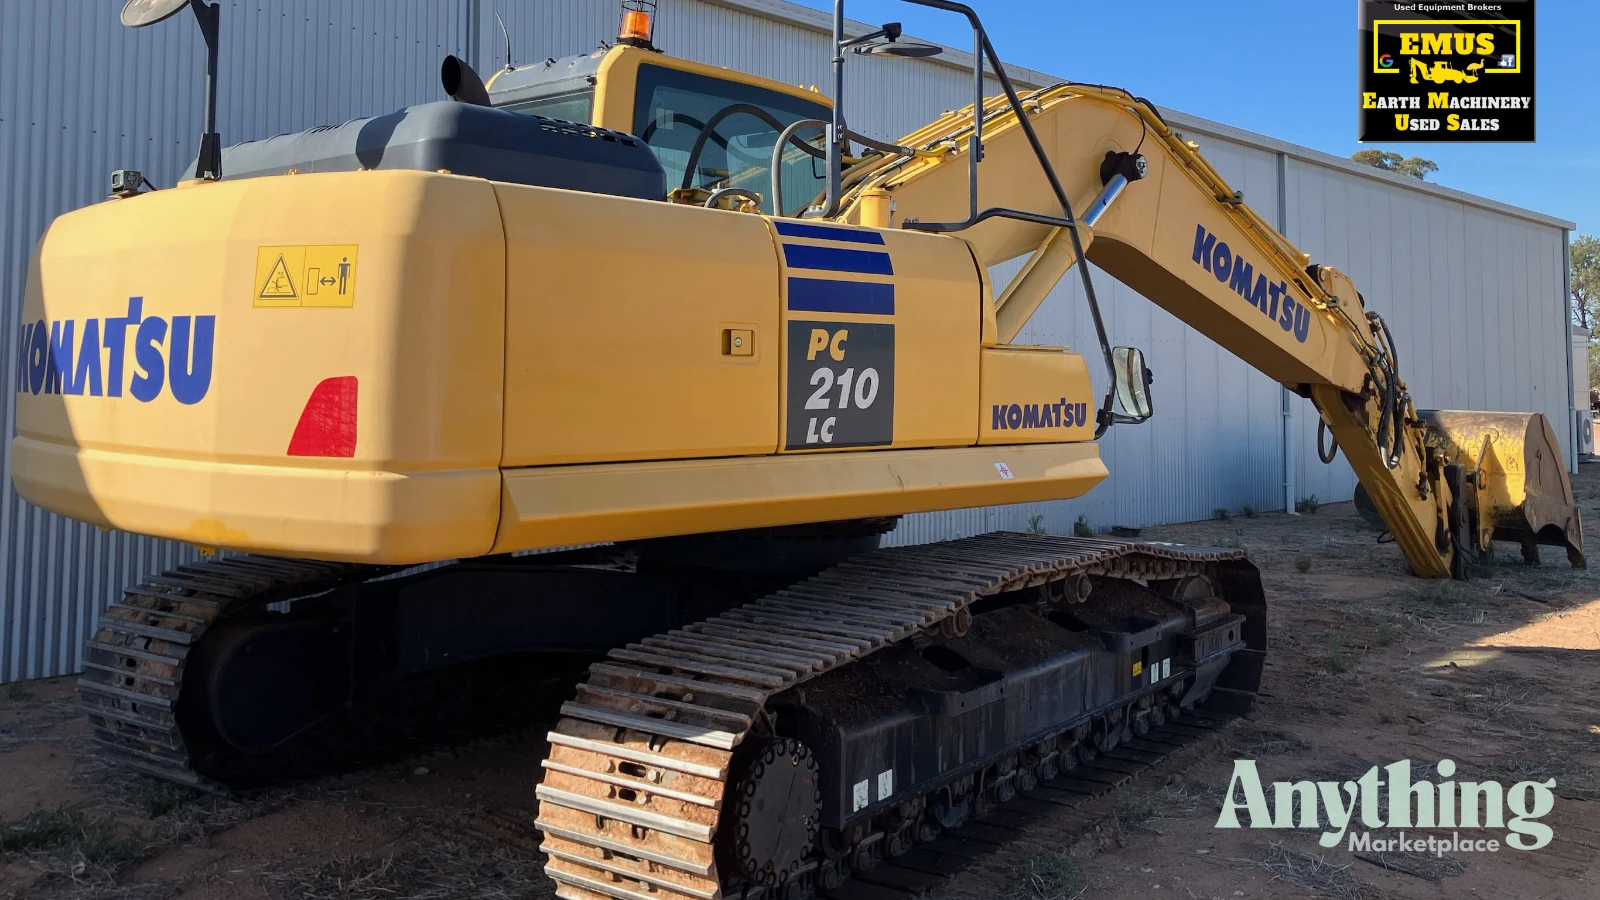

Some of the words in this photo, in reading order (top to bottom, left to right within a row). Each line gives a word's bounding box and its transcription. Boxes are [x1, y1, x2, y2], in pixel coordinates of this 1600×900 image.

[1192, 223, 1311, 343] KOMATSU
[17, 296, 216, 405] KOMATSU
[807, 329, 849, 361] PC
[804, 367, 879, 410] 210
[806, 416, 836, 444] LC
[992, 397, 1087, 430] KOMATSU
